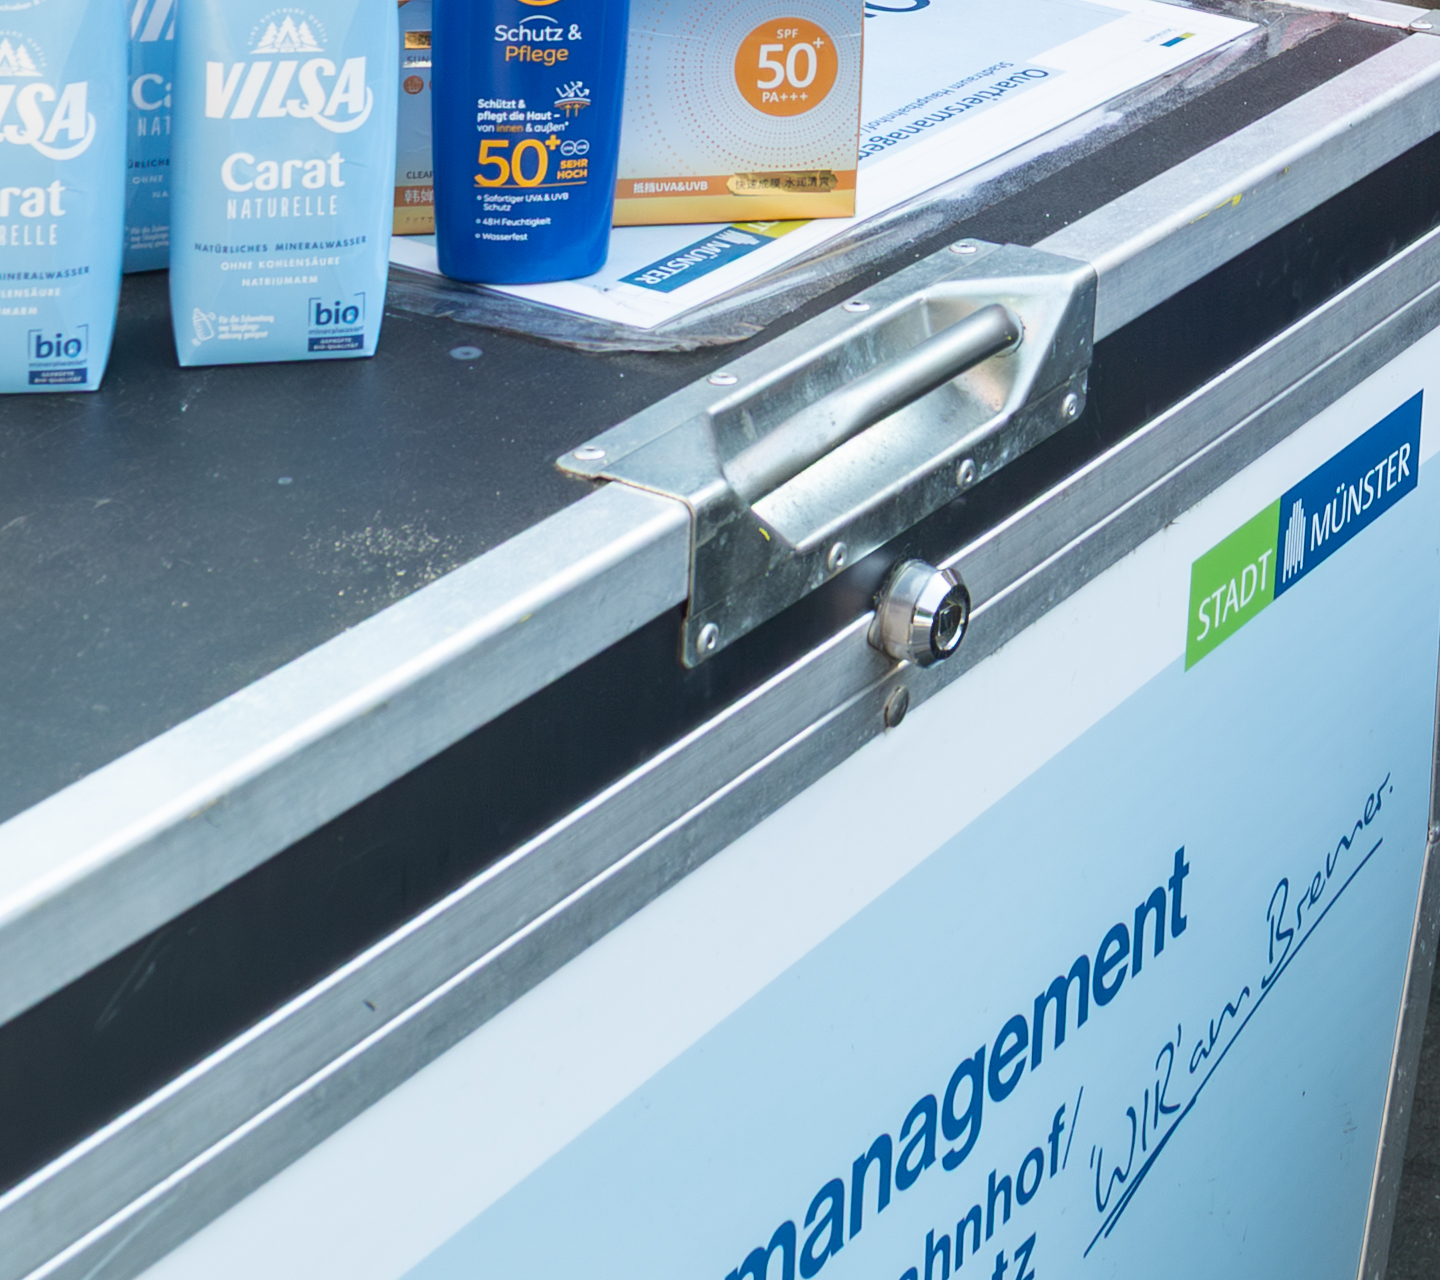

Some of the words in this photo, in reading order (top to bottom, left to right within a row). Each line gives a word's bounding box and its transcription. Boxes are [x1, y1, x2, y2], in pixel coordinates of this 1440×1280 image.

[494, 22, 563, 42] Schutz
[568, 23, 583, 41] &
[776, 28, 799, 40] SPF
[505, 45, 569, 66] Pflege
[949, 60, 1014, 90] Stadtraum
[205, 56, 373, 128] VILSA
[762, 90, 808, 103] PA+++
[477, 98, 516, 109] Schützt
[518, 99, 526, 109] &
[477, 110, 508, 122] pflegt
[509, 110, 526, 121] die
[527, 109, 552, 121] Haut
[477, 124, 495, 133] von
[496, 122, 524, 133] innen
[560, 158, 588, 169] SEHR
[221, 151, 346, 192] Carat
[557, 169, 588, 180] HOCH
[483, 193, 524, 205] Sofortiger
[227, 195, 338, 220] NATURELLE
[483, 202, 512, 212] Schutz
[501, 216, 551, 227] Feuchtigkeit
[482, 232, 528, 242] Wasserfest
[194, 242, 268, 254] NATÜRLICHES
[274, 236, 367, 251] MINERALWASSER
[220, 261, 253, 271] OHNE
[258, 256, 341, 270] KOHLENSÄURE
[640, 239, 731, 286] MÜNSTER
[315, 300, 359, 326] bio
[35, 333, 82, 359] bio
[1196, 548, 1273, 642] STADT
[1310, 441, 1411, 552] MÜNSTER
